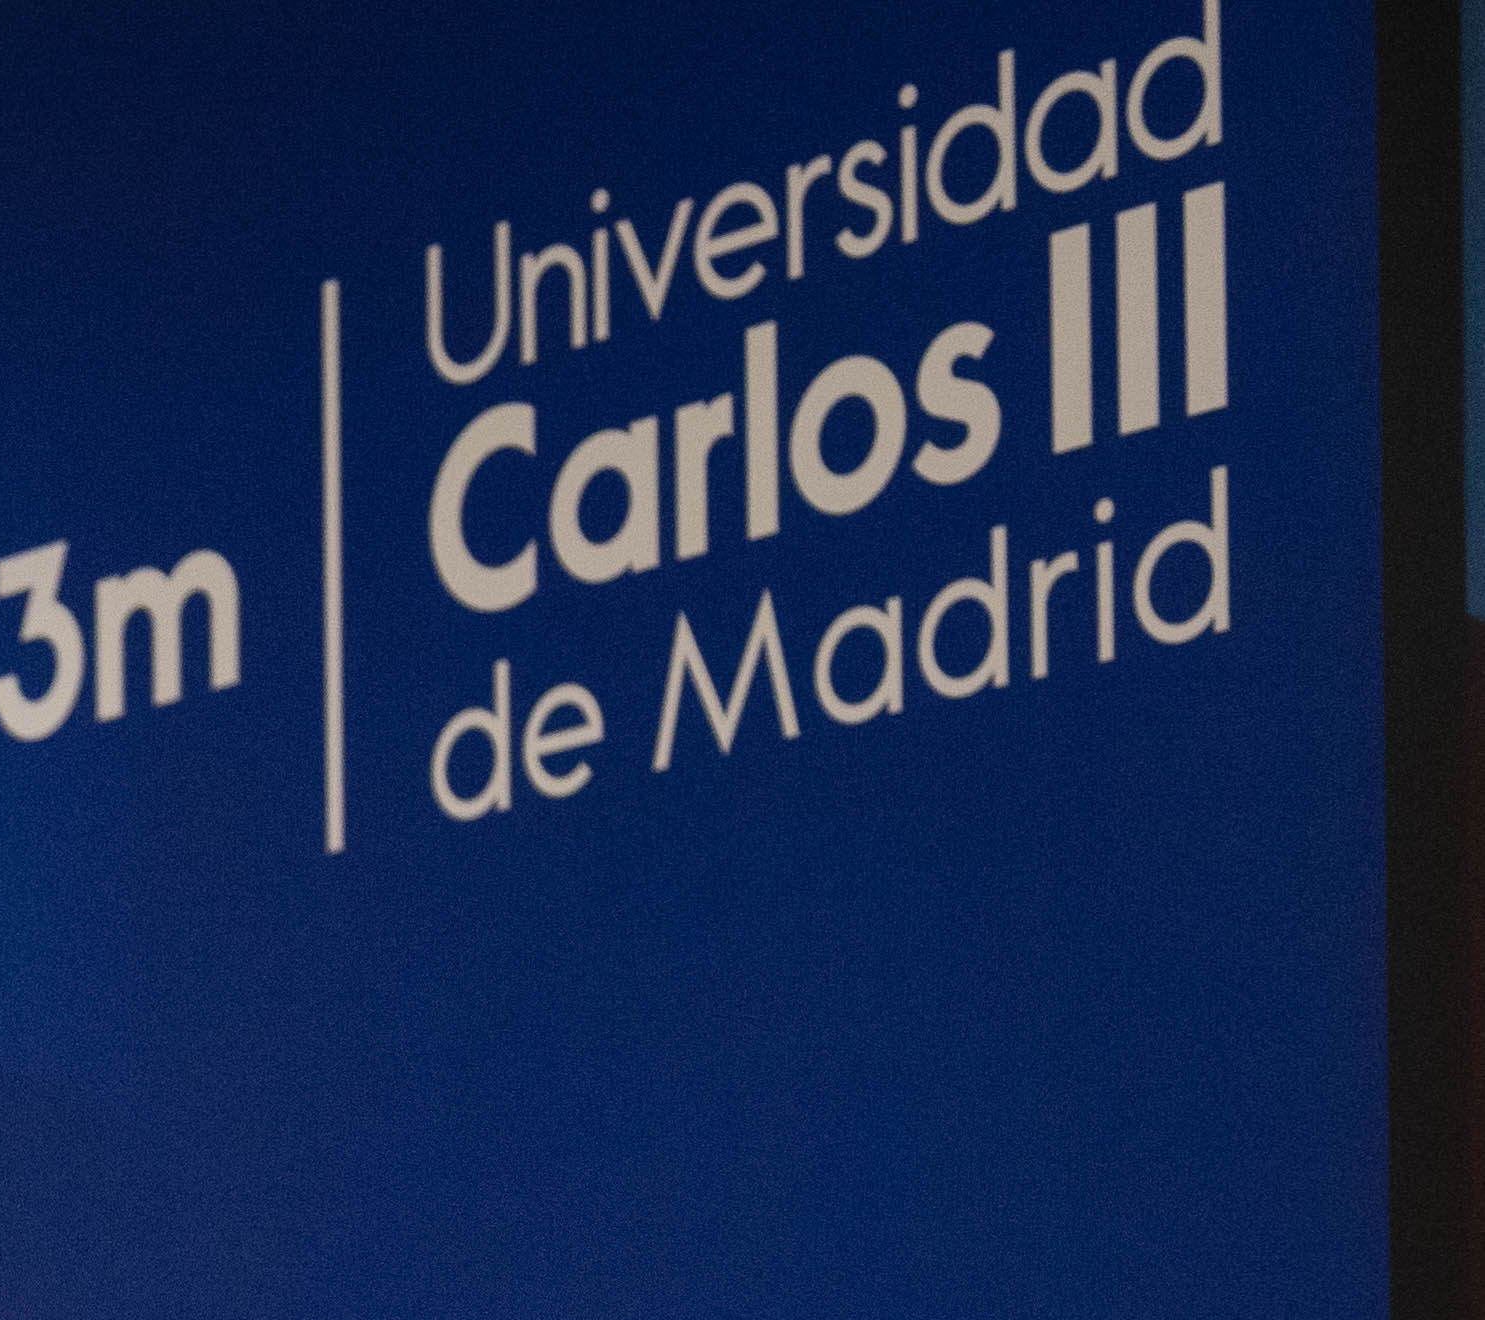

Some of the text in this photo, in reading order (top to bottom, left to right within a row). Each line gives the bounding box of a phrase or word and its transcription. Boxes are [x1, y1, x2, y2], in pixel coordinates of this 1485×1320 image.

[426, 0, 1224, 385] Universidad
[428, 181, 1229, 614] Carlos III
[430, 466, 1232, 822] de Madrid
